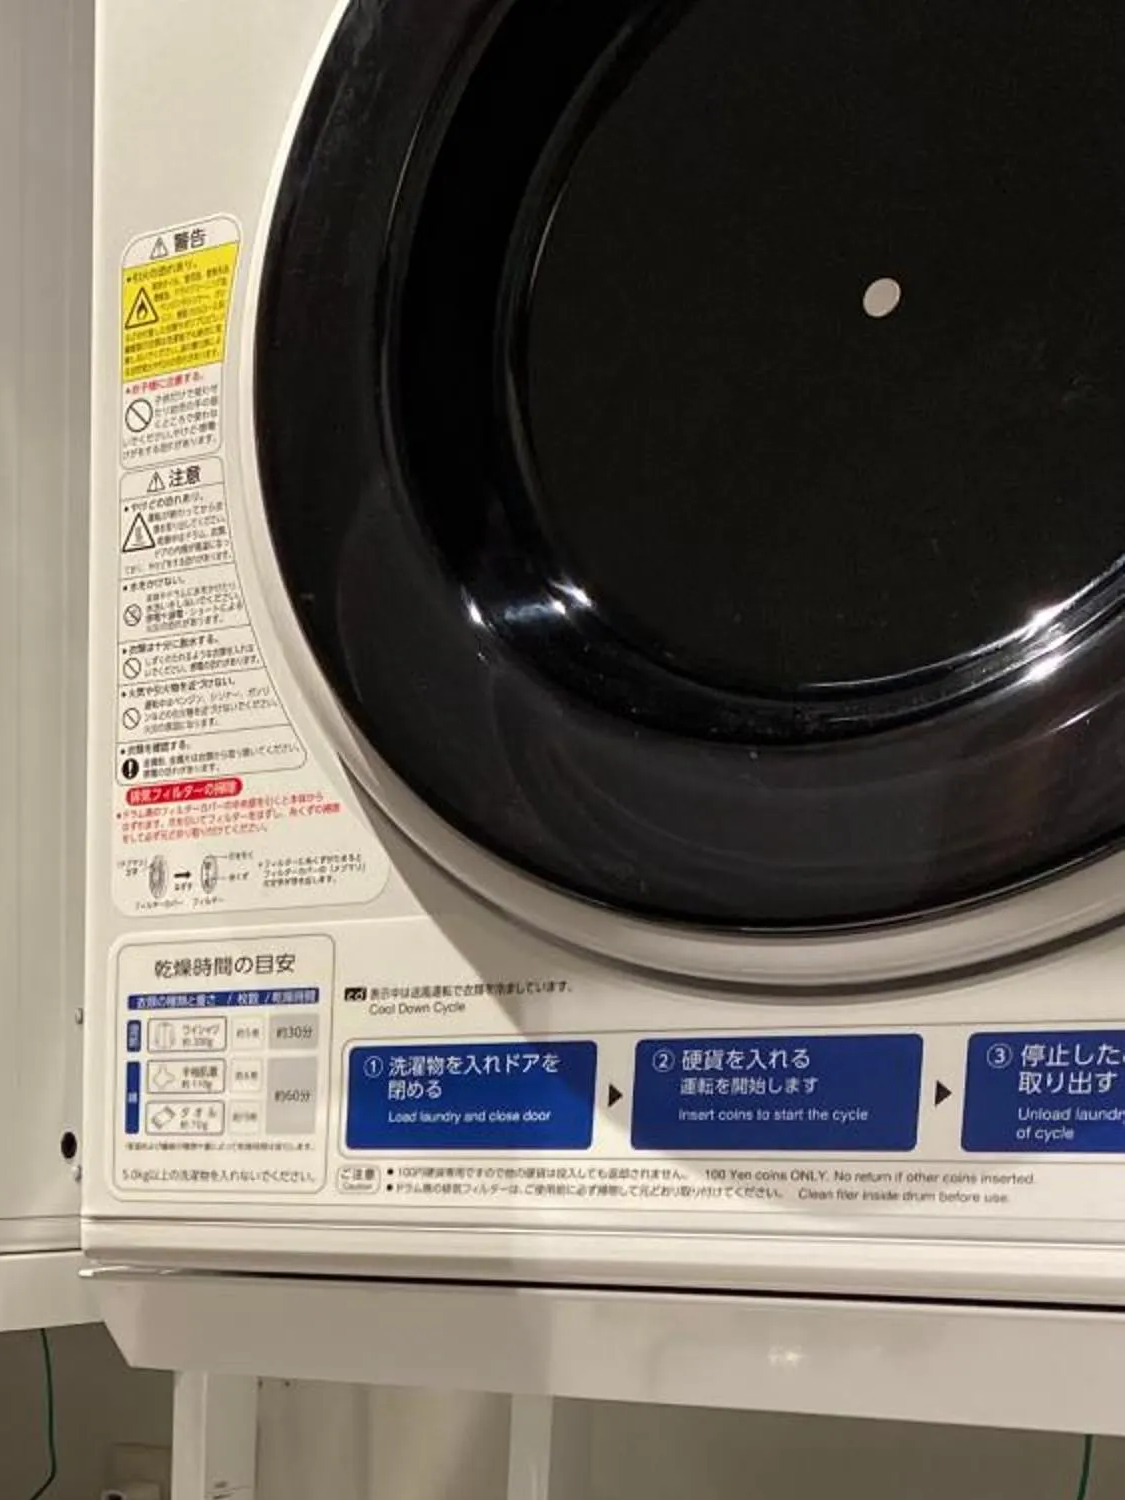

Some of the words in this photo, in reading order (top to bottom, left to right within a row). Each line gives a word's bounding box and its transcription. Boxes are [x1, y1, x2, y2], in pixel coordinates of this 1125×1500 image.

[175, 228, 206, 252] 警告
[169, 465, 201, 487] 注意
[154, 953, 296, 979] 乾燥時間の目安
[369, 1003, 395, 1016] Cool
[398, 1002, 431, 1015] Down
[433, 1000, 466, 1016] Cycle
[276, 1026, 314, 1039] 約30分
[681, 1048, 811, 1072] 硬貨を入れる
[1021, 1043, 1125, 1068] 停止した
[388, 1054, 561, 1077] 洗濯物を入れドアを
[387, 1080, 443, 1101] 閉める
[680, 1076, 819, 1096] 運転を開始します
[1018, 1070, 1119, 1095] 取り出す
[275, 1089, 311, 1102] 約60分
[388, 1109, 417, 1123] Load
[420, 1109, 461, 1125] laundry
[464, 1109, 486, 1122] and
[489, 1109, 520, 1122] close
[523, 1109, 551, 1122] door
[679, 1107, 715, 1121] Insert
[718, 1108, 753, 1121] coins
[756, 1108, 771, 1121] to
[774, 1108, 805, 1121] start
[808, 1108, 829, 1121] the
[833, 1107, 869, 1123] cycle
[1018, 1107, 1072, 1121] Unload
[1016, 1127, 1032, 1140] of
[1035, 1127, 1075, 1144] cycle
[340, 1168, 375, 1181] ご注意
[705, 1169, 726, 1181] 100
[730, 1169, 752, 1181] Yen
[755, 1169, 787, 1182] coins
[834, 1170, 852, 1182] No
[854, 1171, 892, 1183] return
[894, 1170, 903, 1183] if
[906, 1171, 940, 1183] other
[943, 1172, 980, 1184] coins
[798, 1187, 833, 1200] Clean
[862, 1189, 898, 1201] inside
[902, 1190, 935, 1202] drum
[939, 1191, 980, 1203] before
